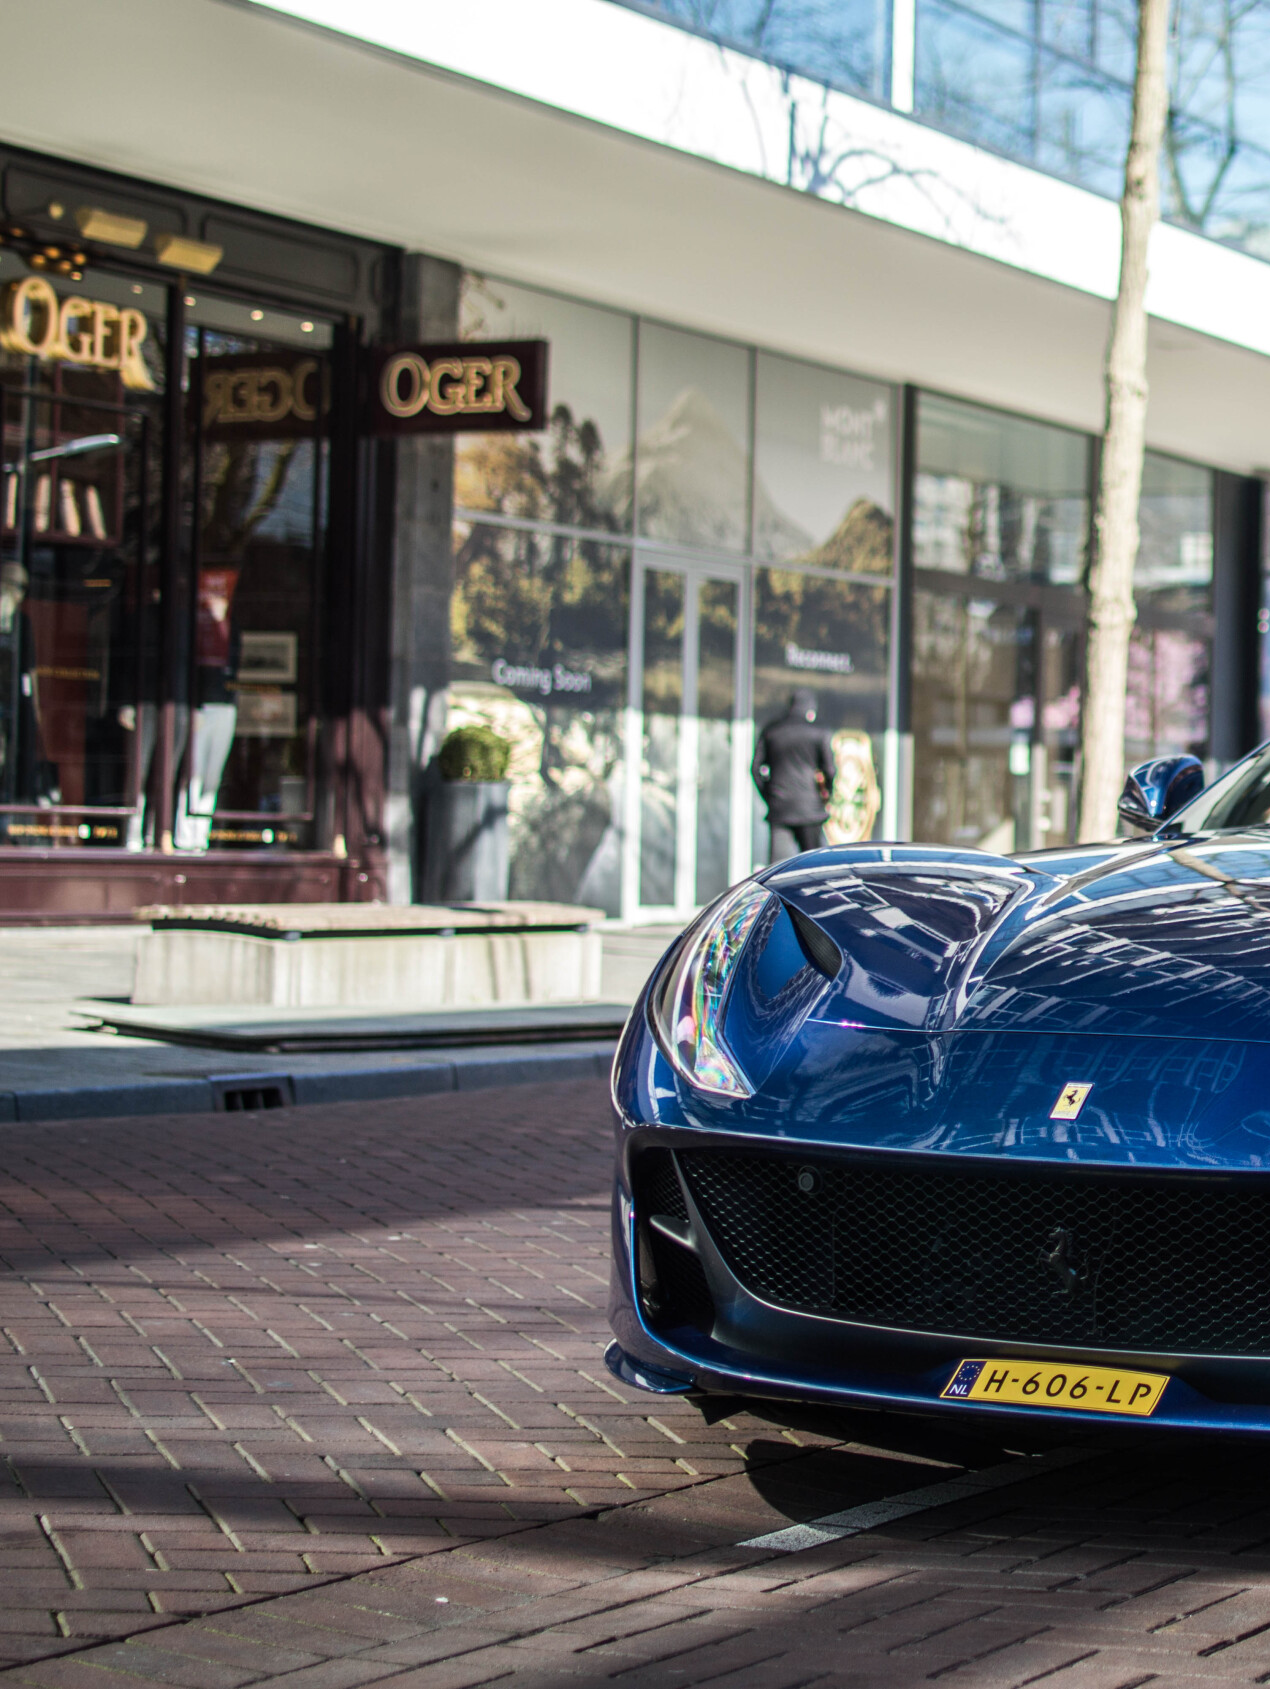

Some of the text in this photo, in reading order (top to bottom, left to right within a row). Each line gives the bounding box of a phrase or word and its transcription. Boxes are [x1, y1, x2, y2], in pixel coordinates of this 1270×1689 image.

[8, 276, 157, 391] OGER
[379, 352, 532, 422] OGER
[492, 658, 592, 695] Coming Soon
[949, 1383, 968, 1395] NL
[983, 1370, 1152, 1405] H-606-LP
